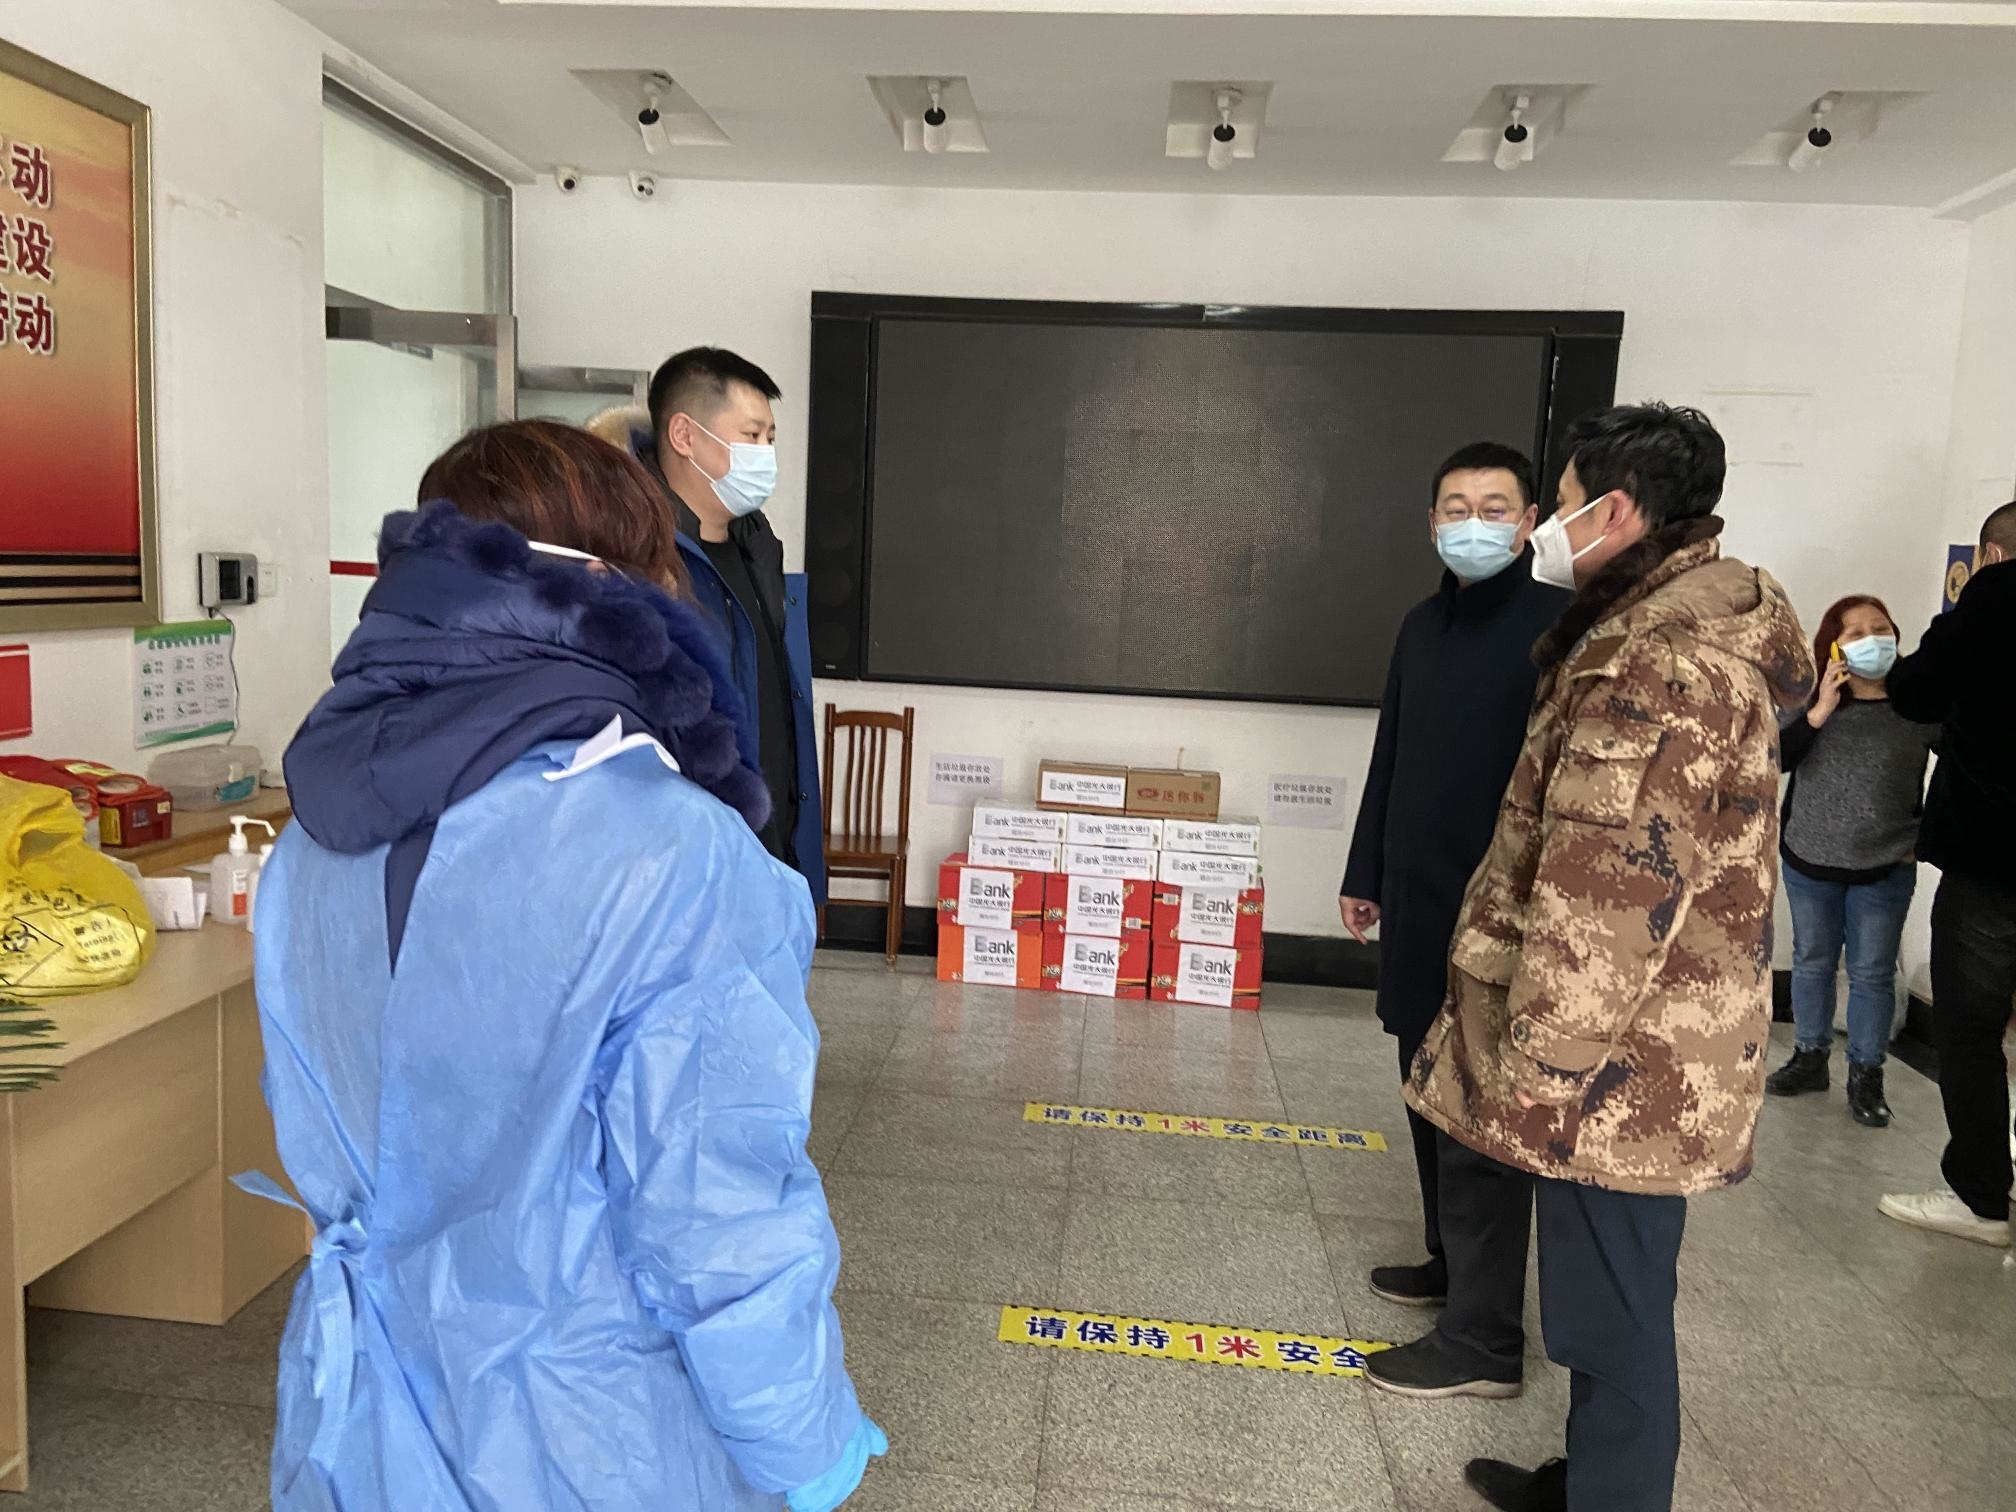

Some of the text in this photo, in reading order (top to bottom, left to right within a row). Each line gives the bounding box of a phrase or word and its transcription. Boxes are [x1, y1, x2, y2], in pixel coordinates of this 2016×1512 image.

[0, 141, 50, 205] 动
[0, 213, 52, 281] 设
[0, 286, 53, 353] 动
[1043, 1106, 1367, 1147] 请保持1米安全距离
[1025, 1315, 1366, 1369] 请保持1米安全
